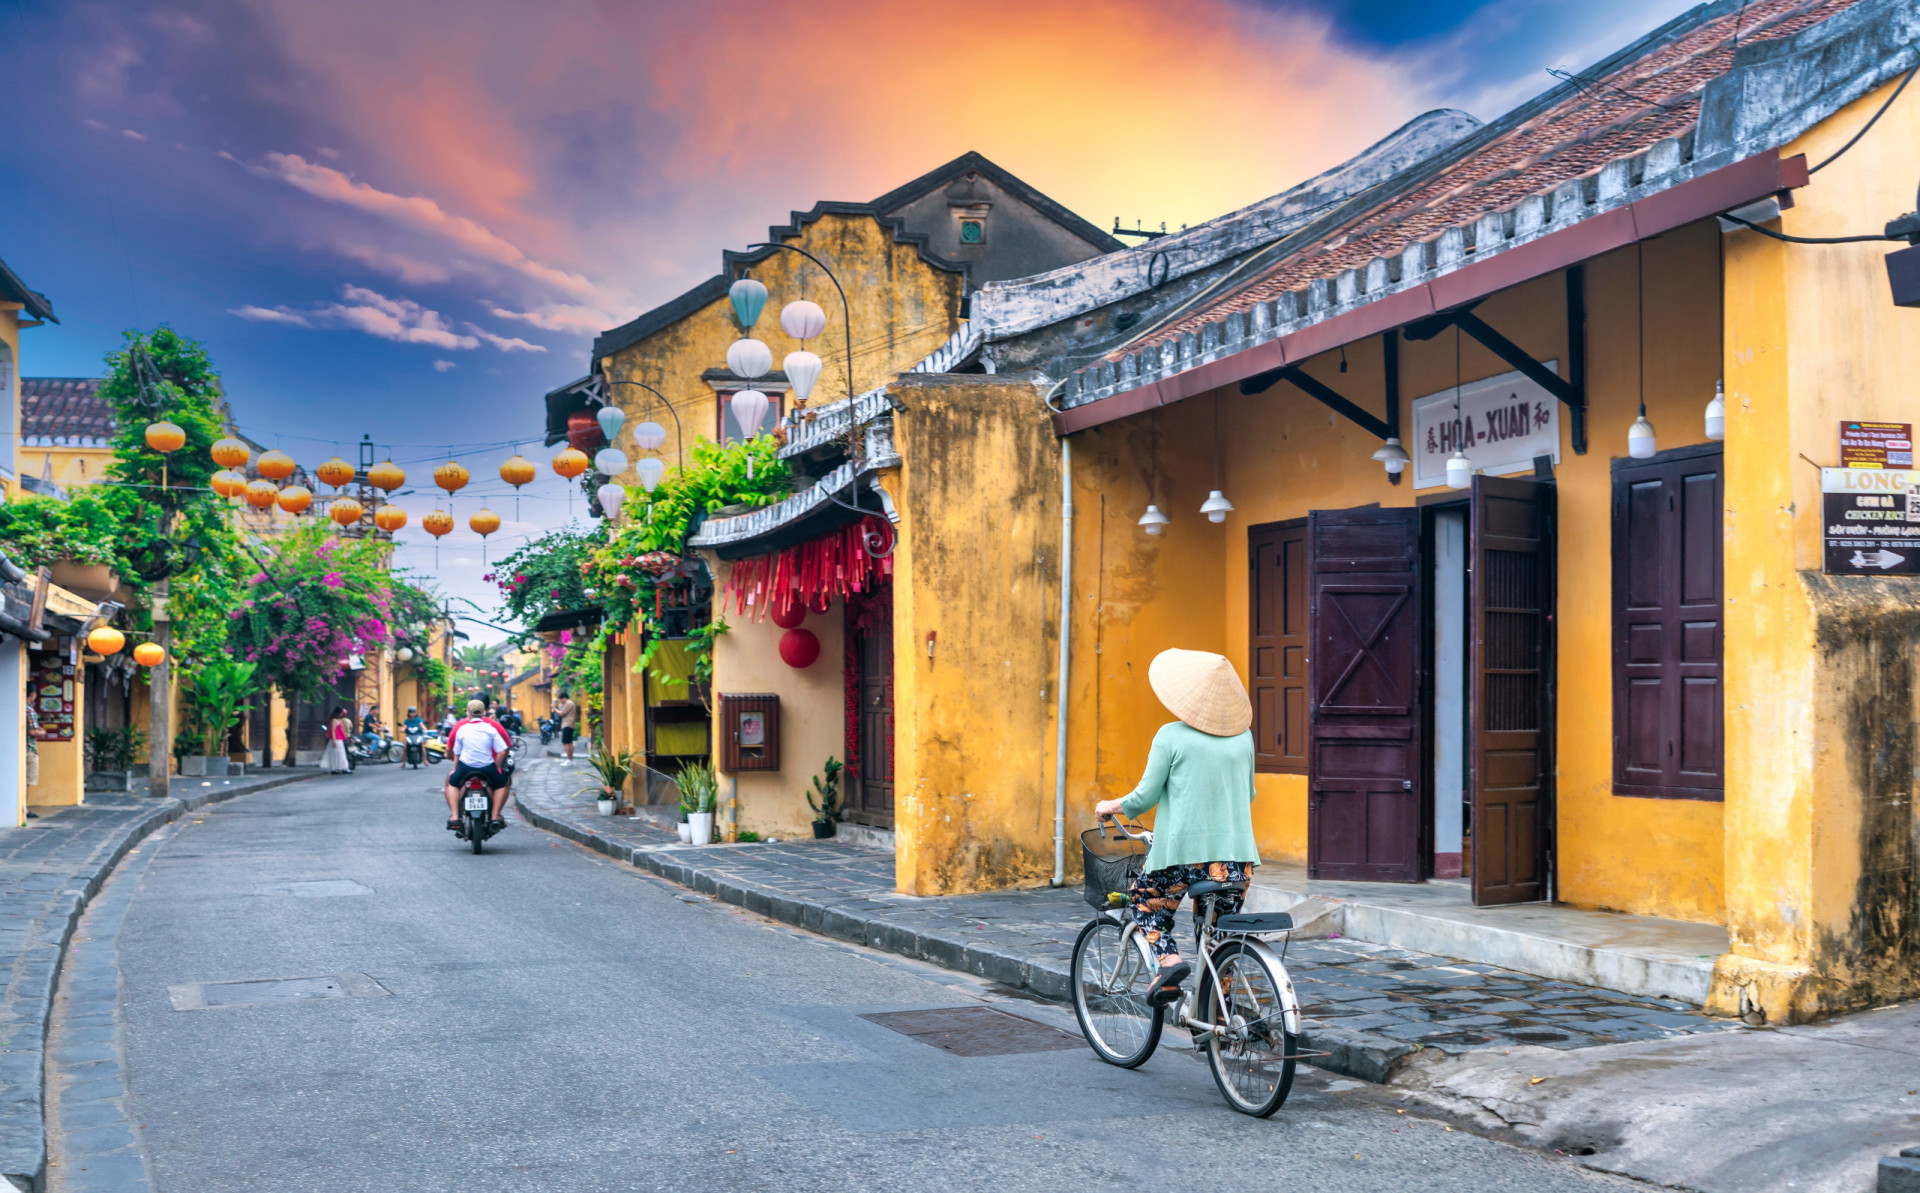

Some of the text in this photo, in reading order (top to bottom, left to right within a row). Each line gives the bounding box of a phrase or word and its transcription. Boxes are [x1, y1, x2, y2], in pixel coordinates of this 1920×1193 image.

[1843, 471, 1906, 490] LONG
[1845, 510, 1885, 520] CHICKEN
[1884, 510, 1906, 520] RICE
